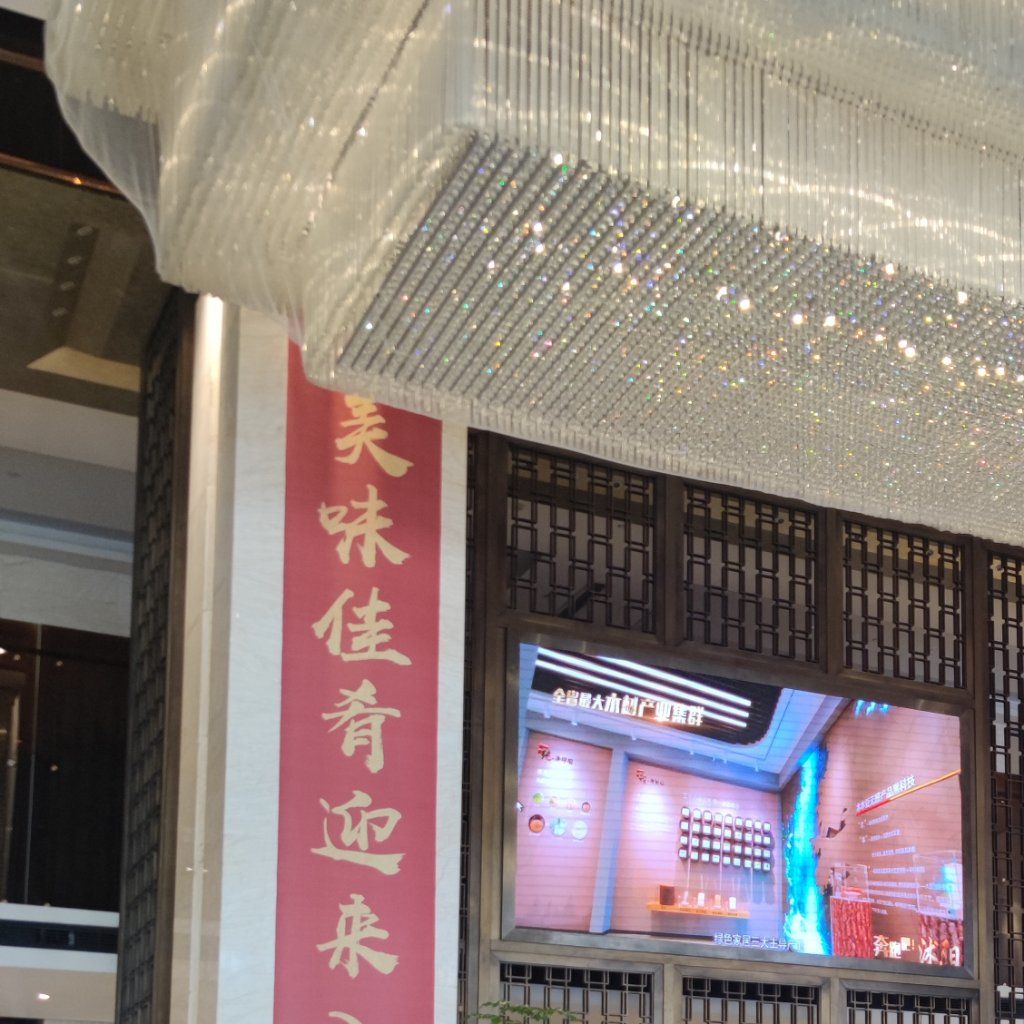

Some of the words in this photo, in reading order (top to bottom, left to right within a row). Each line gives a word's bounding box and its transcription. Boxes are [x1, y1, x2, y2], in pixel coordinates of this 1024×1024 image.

[552, 687, 704, 727] 全省最大木材产业集群
